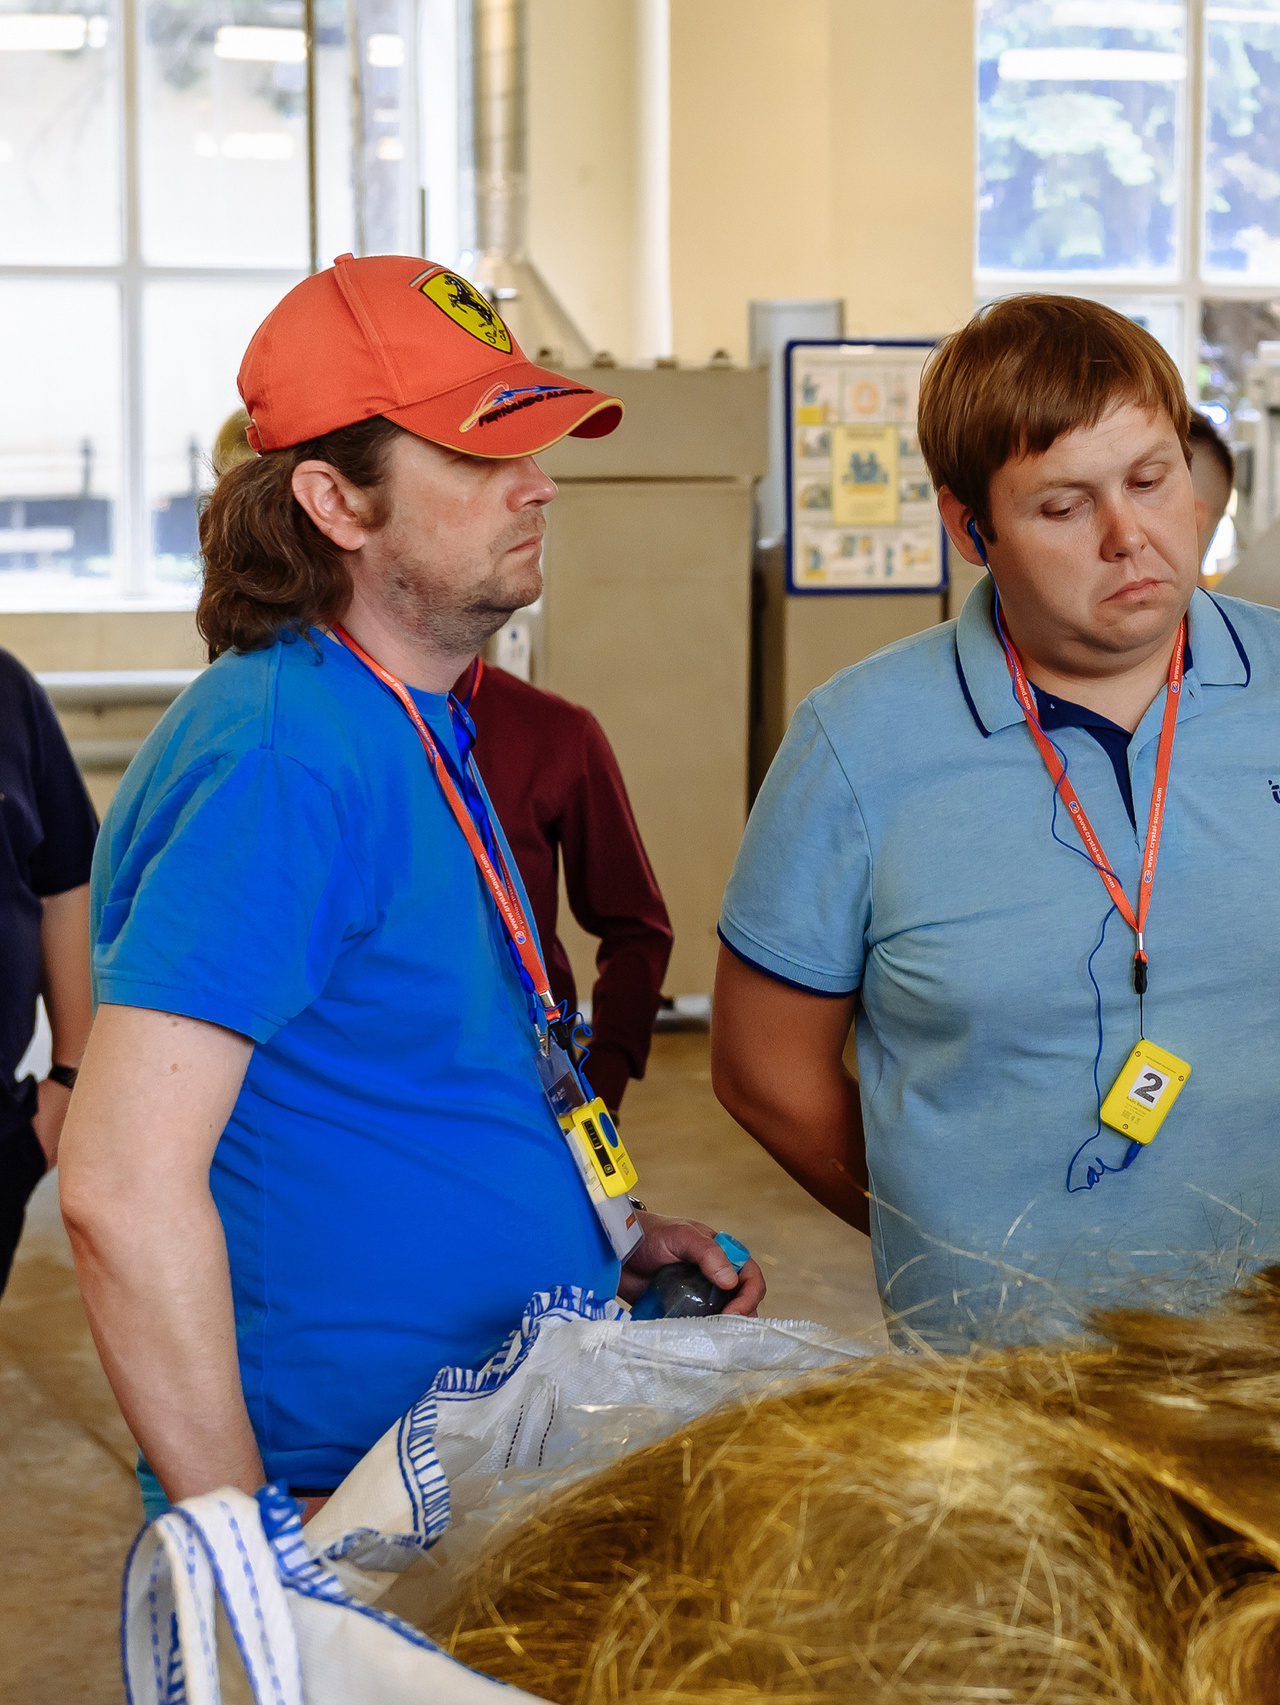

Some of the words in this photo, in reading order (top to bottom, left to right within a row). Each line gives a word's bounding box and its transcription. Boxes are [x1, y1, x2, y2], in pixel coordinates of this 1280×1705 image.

[479, 394, 545, 427] FERNANDO
[1147, 787, 1162, 868] www.crystal-sound.com
[480, 853, 519, 931] www.crystal-sound.com
[1133, 1072, 1163, 1103] 2
